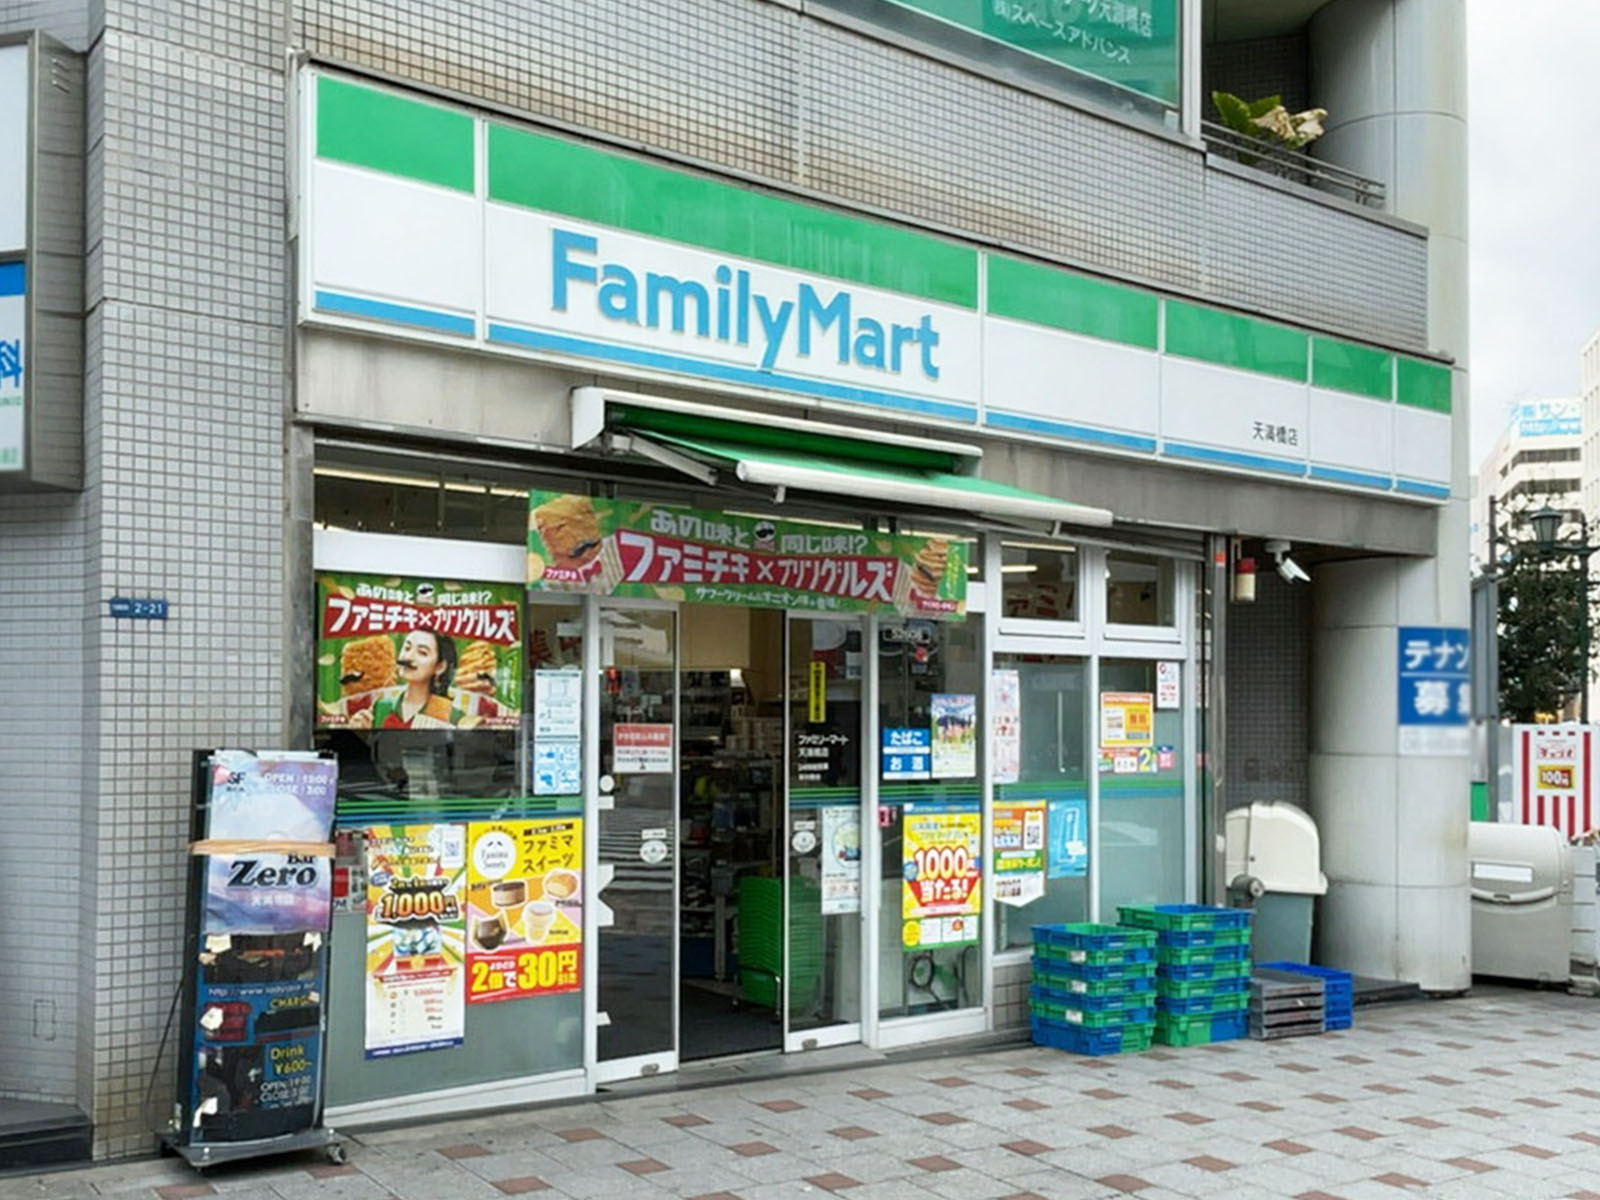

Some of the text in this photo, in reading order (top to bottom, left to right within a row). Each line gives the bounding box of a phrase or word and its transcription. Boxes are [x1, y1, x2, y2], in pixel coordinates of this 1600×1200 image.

[550, 227, 941, 380] FamilyMart
[651, 509, 750, 548] あの味と
[134, 602, 163, 614] 2-21
[890, 731, 923, 746] たばこ
[522, 834, 574, 855] ファミマ
[227, 859, 317, 888] Zero
[522, 852, 574, 875] スイーツ
[270, 1045, 304, 1060] Drink
